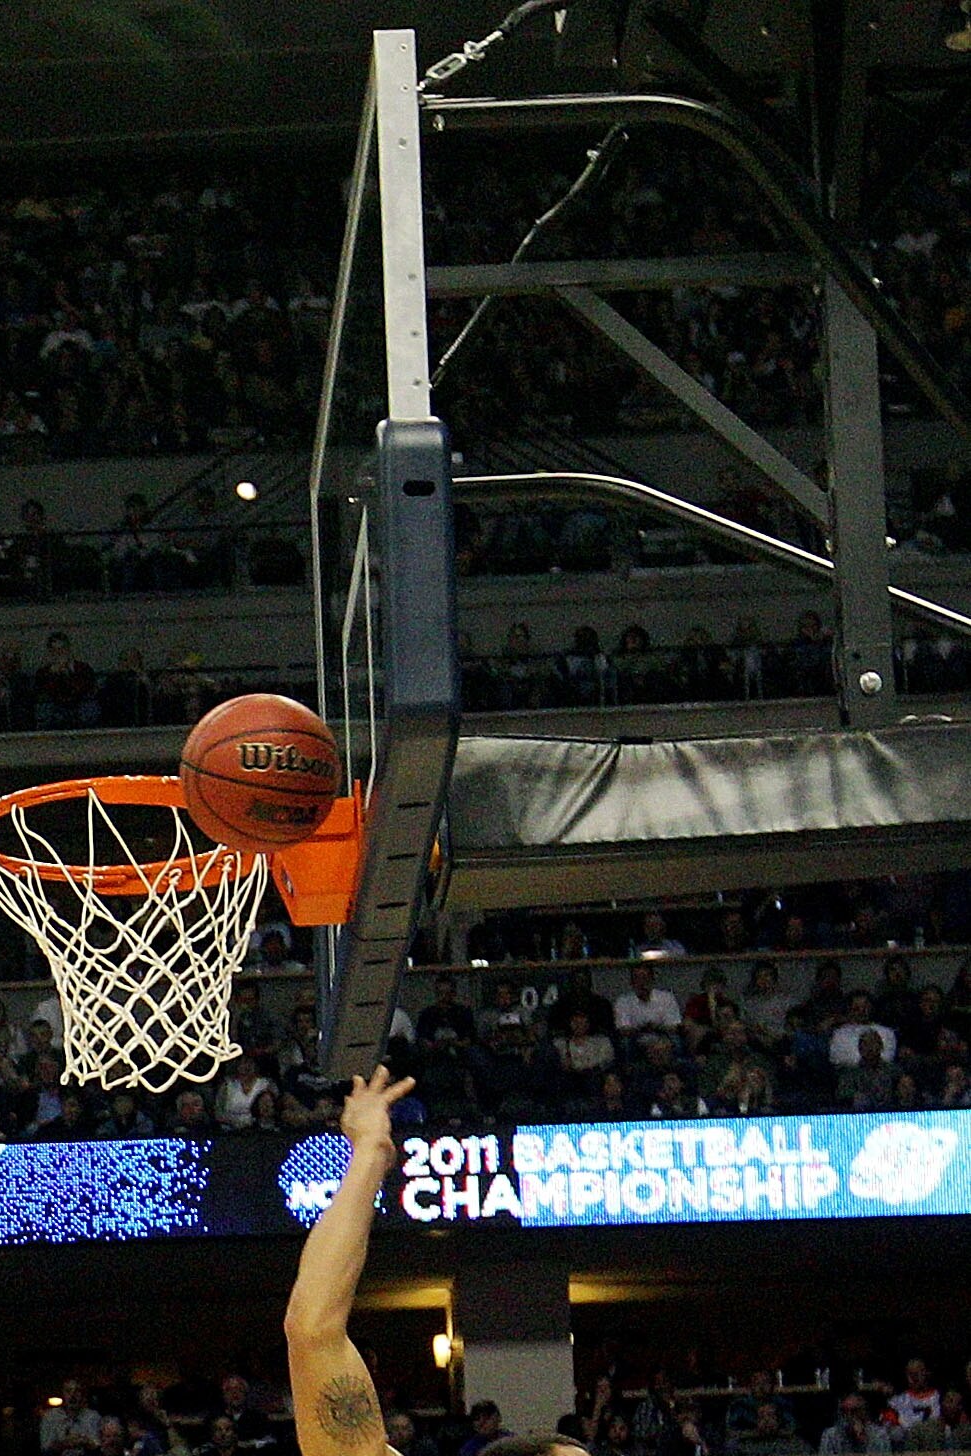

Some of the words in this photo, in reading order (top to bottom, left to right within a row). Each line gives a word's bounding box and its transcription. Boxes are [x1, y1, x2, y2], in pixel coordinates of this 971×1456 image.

[237, 742, 337, 777] Wilson
[403, 1134, 501, 1177] 2011
[514, 1124, 830, 1173] BASKETBALL
[402, 1164, 838, 1221] CHAMPIONSHIP
